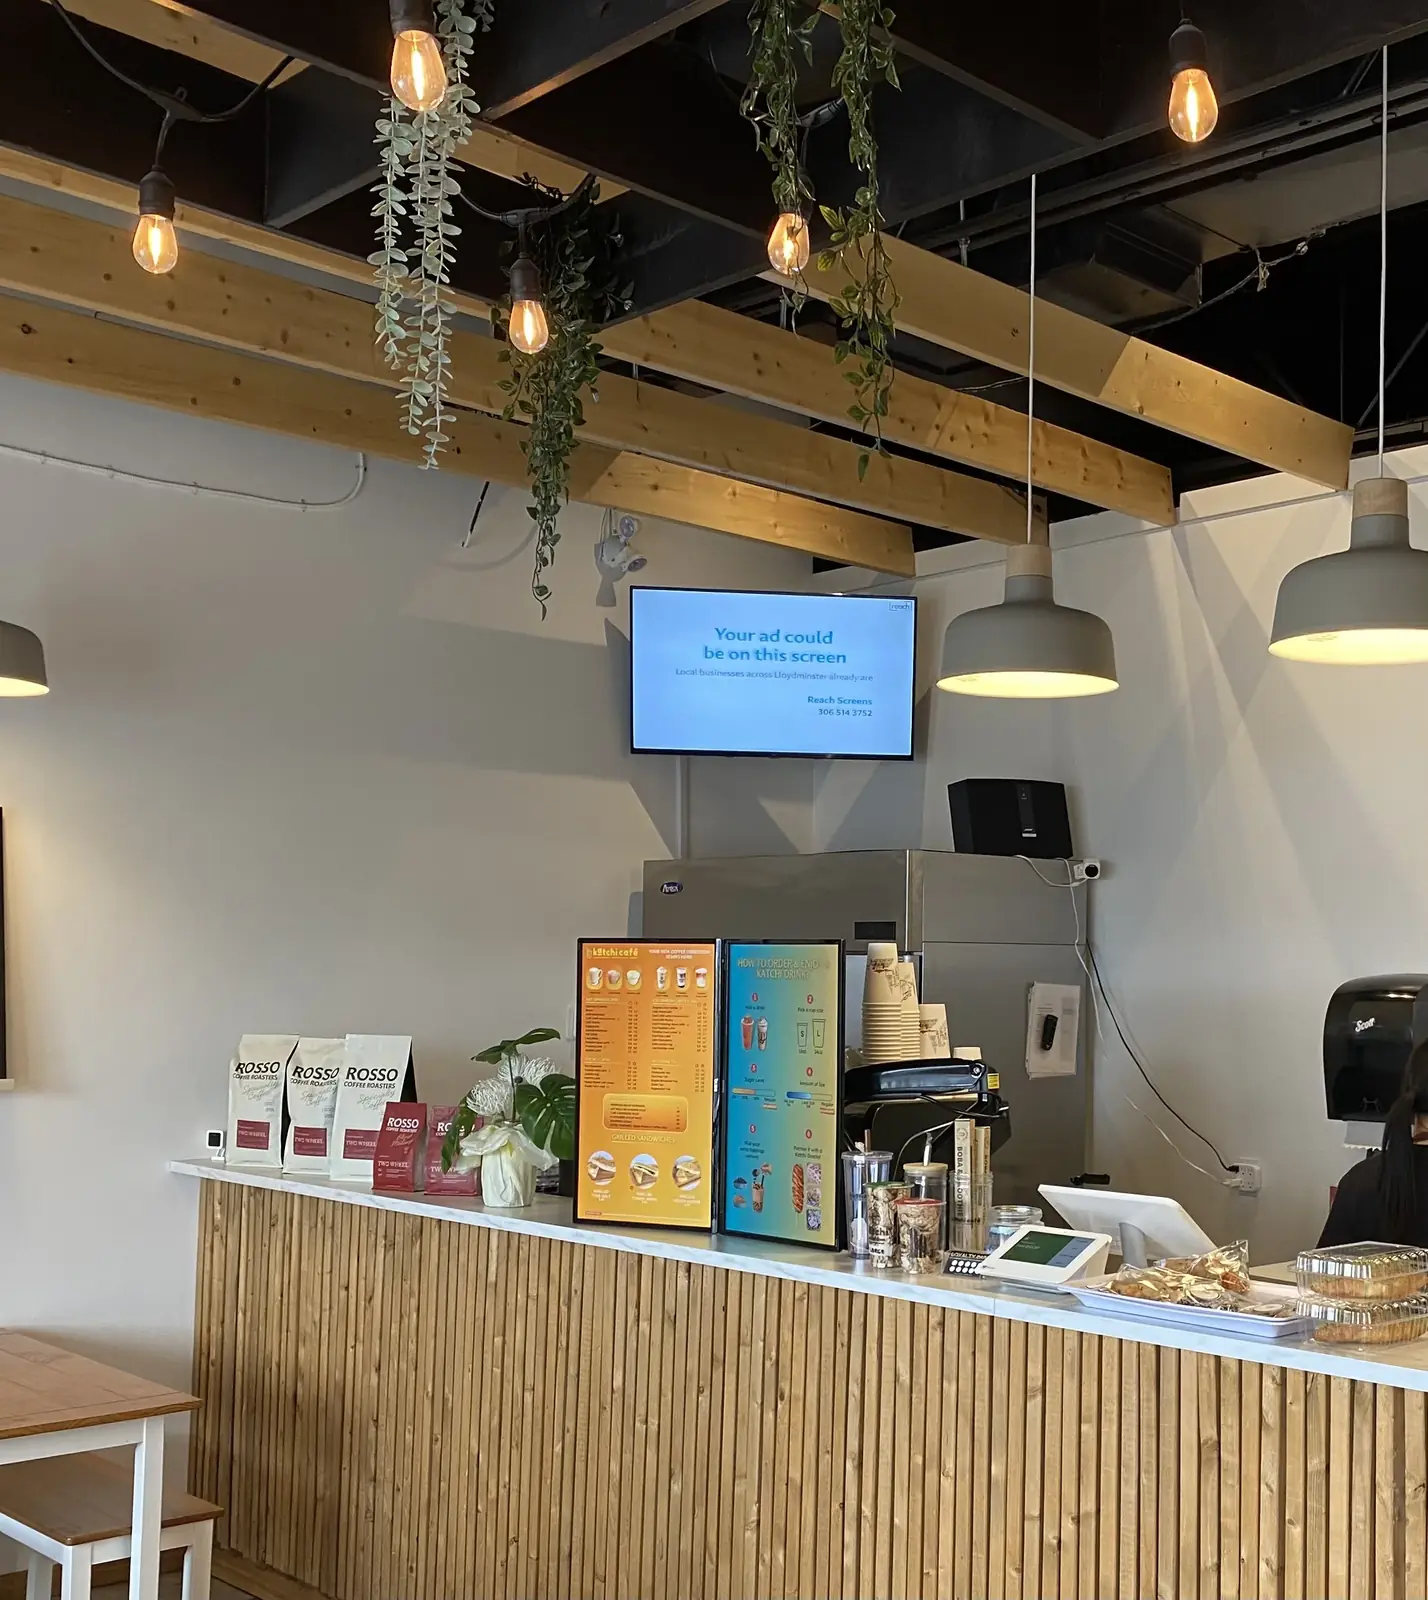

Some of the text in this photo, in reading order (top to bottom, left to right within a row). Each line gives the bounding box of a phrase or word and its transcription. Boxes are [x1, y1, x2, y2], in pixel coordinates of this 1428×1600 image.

[715, 627, 833, 644] Your ad could
[704, 646, 847, 664] be on this screen
[675, 668, 698, 676] Local
[699, 669, 745, 678] businesses
[746, 671, 772, 679] across
[774, 671, 827, 681] Lloydminster
[829, 672, 858, 683] already
[807, 696, 873, 705] Reach Screens
[818, 708, 873, 717] 306 514 3752
[619, 947, 639, 957] café
[738, 959, 754, 968] HOW
[767, 959, 793, 969] ORDER
[1355, 1017, 1376, 1033] Scott
[235, 1061, 281, 1074] ROSSO
[291, 1065, 340, 1080] ROSSO
[232, 1072, 250, 1080] COFFEE
[345, 1066, 399, 1082] ROSSO
[290, 1078, 309, 1086] COFFEE
[343, 1080, 366, 1088] COFFEE
[387, 1117, 419, 1129] ROSSO
